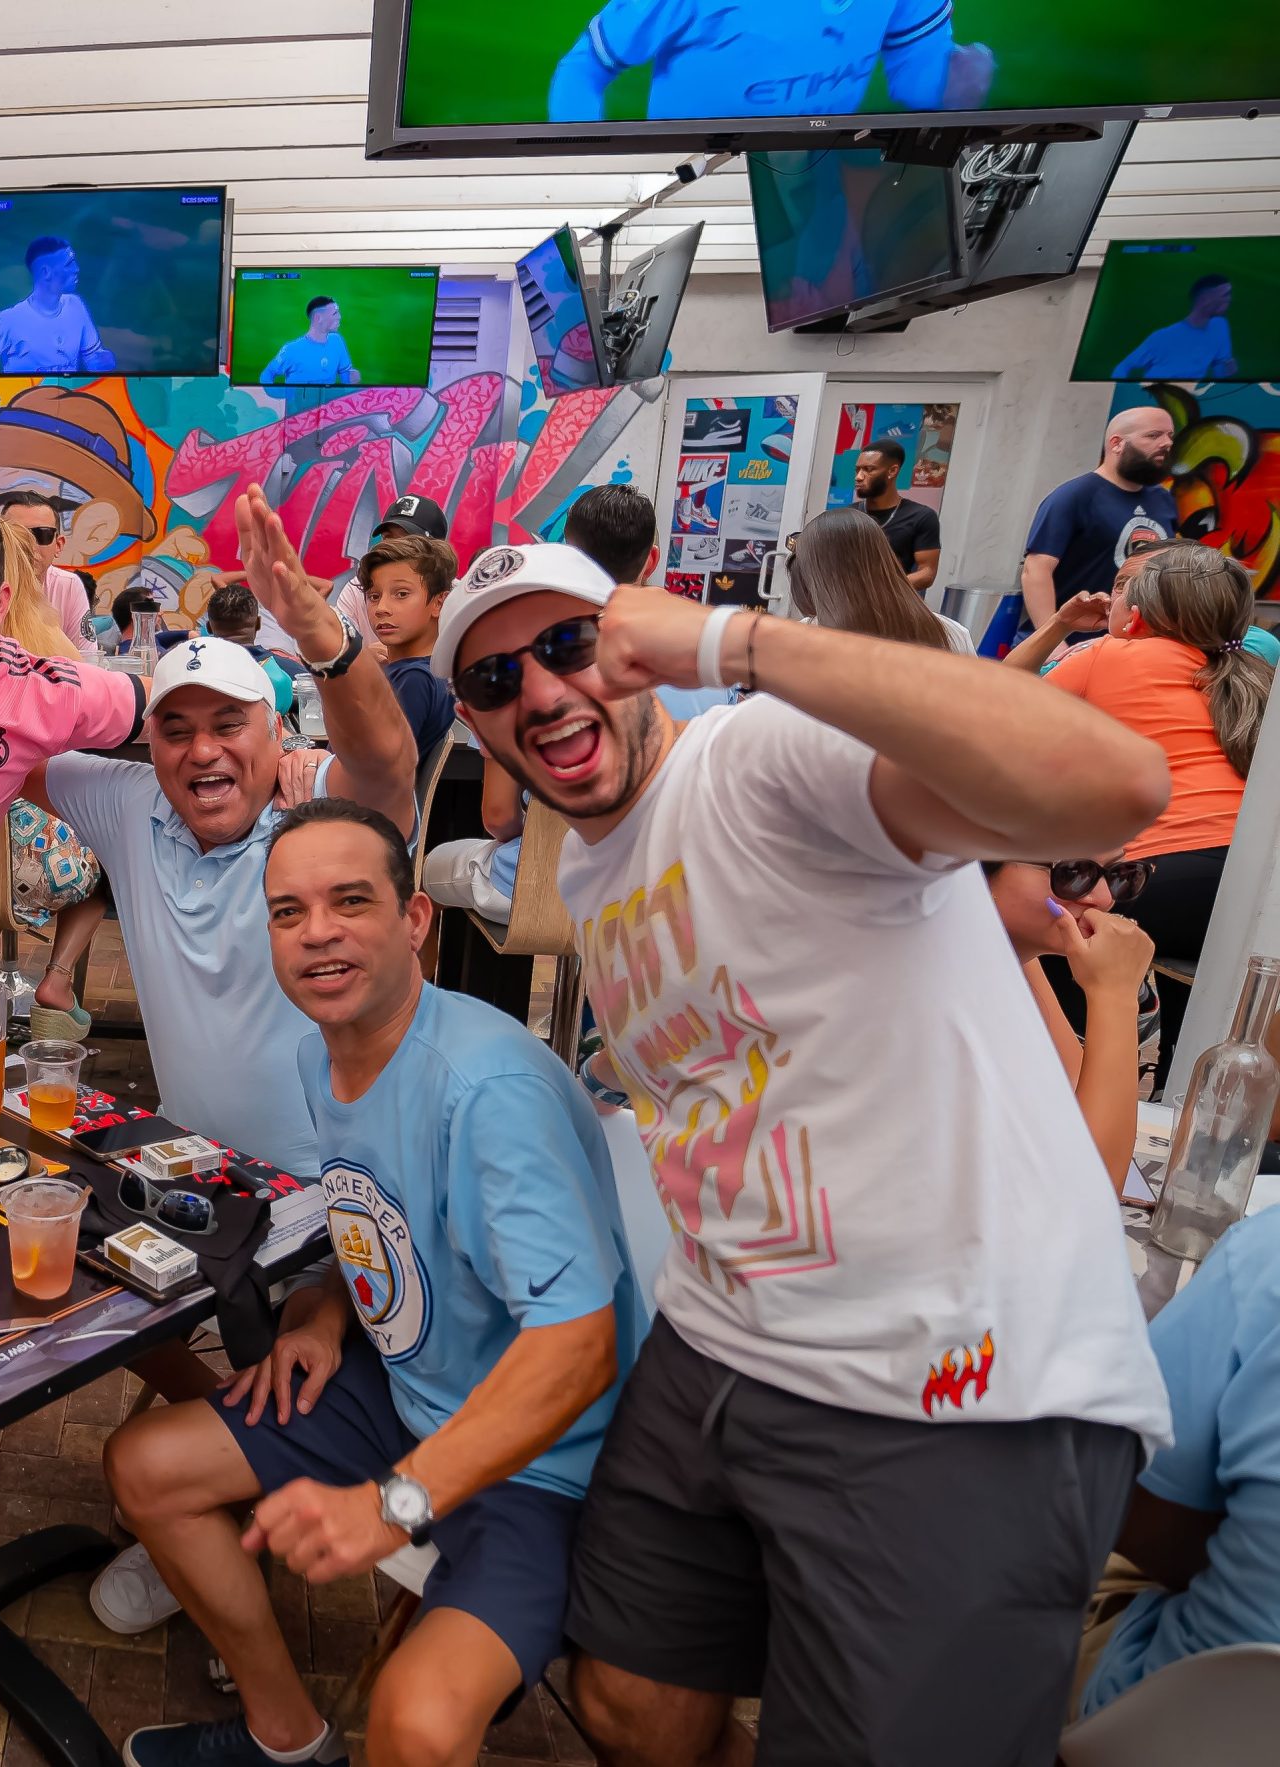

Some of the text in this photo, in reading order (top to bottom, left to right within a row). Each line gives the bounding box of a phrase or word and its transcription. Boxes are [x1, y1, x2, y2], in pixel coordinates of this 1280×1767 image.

[678, 458, 726, 482] NIKE
[738, 468, 773, 480] VISION
[746, 459, 769, 471] PRO
[323, 1173, 407, 1244] NCHESTER
[145, 1244, 185, 1265] Marlboro
[10, 1339, 36, 1358] new
